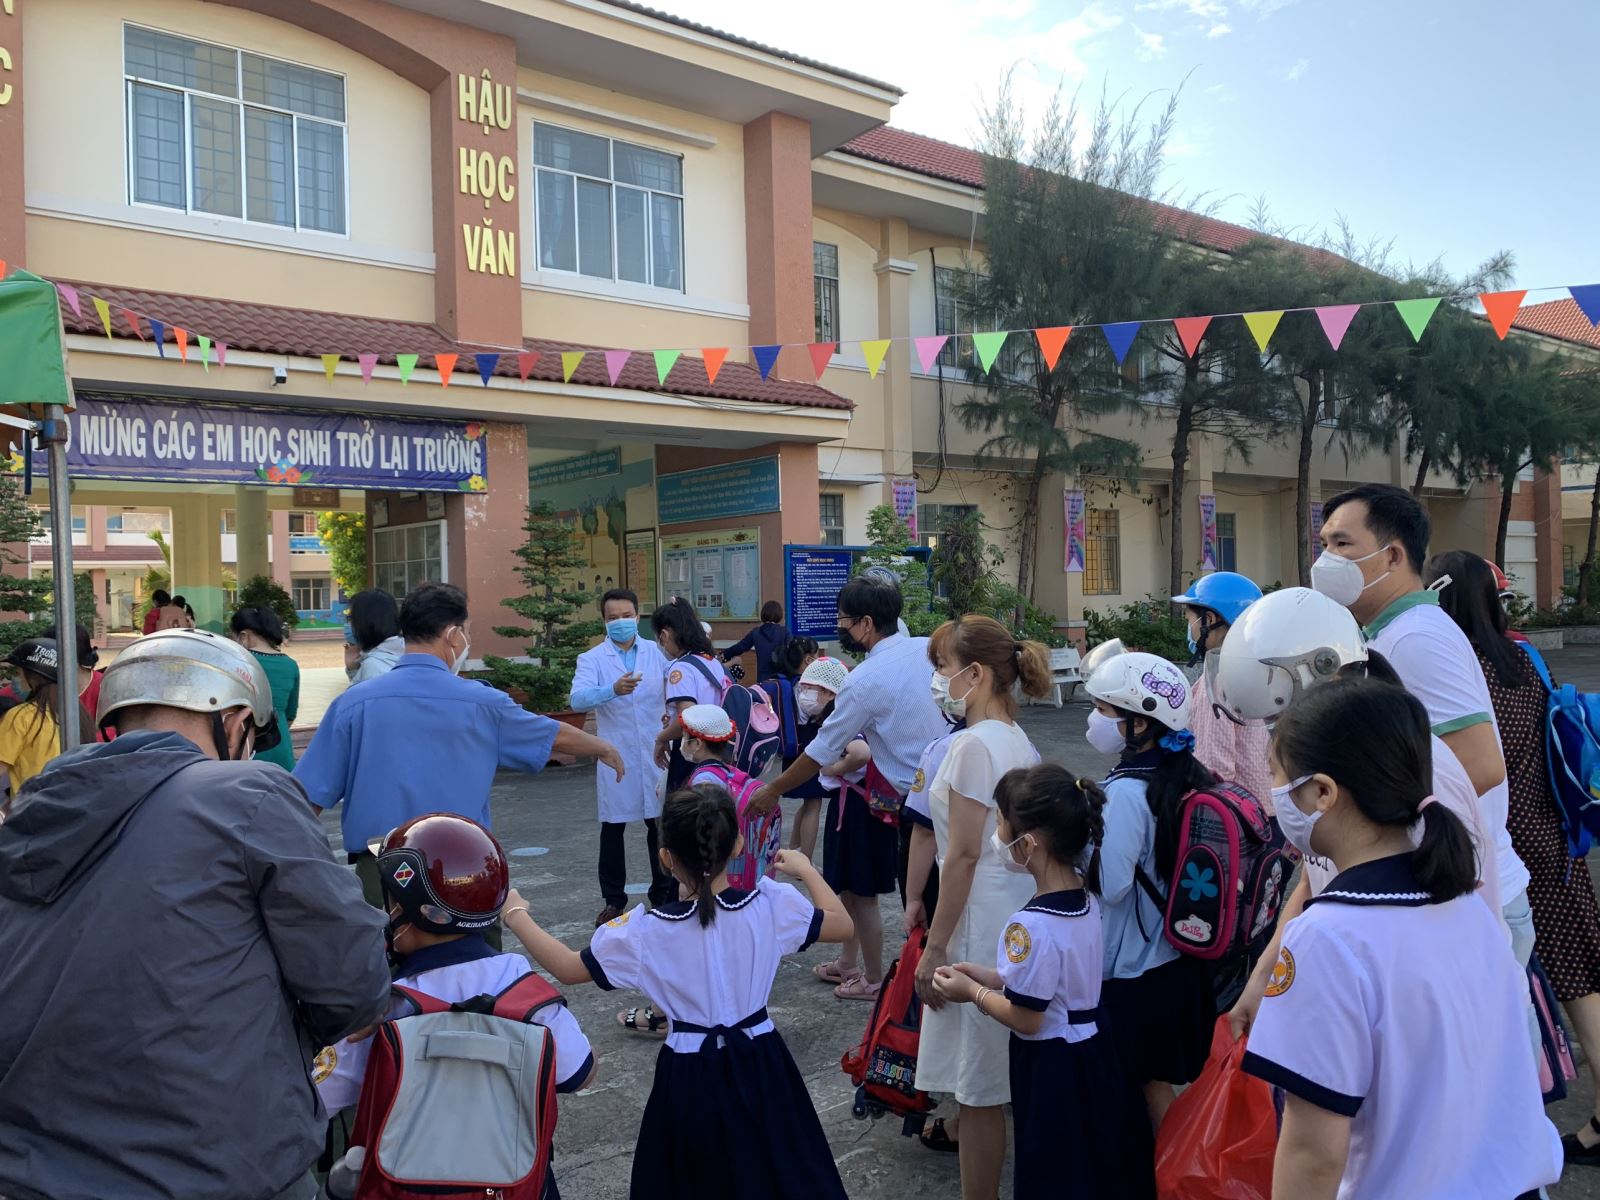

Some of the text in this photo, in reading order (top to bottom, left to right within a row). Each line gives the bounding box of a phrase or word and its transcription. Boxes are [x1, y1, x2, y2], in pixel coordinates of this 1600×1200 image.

[458, 68, 512, 135] HẬU
[459, 147, 515, 208] HỌC
[462, 217, 515, 277] VĂN
[79, 405, 146, 459] MỪNG
[153, 410, 196, 460] CÁC
[203, 423, 234, 462] EM
[240, 426, 281, 470] HỌC
[287, 427, 331, 466] SINH
[336, 419, 375, 469] TRỞ
[380, 434, 409, 477] LẠI
[413, 430, 482, 475] TRƯỜNG
